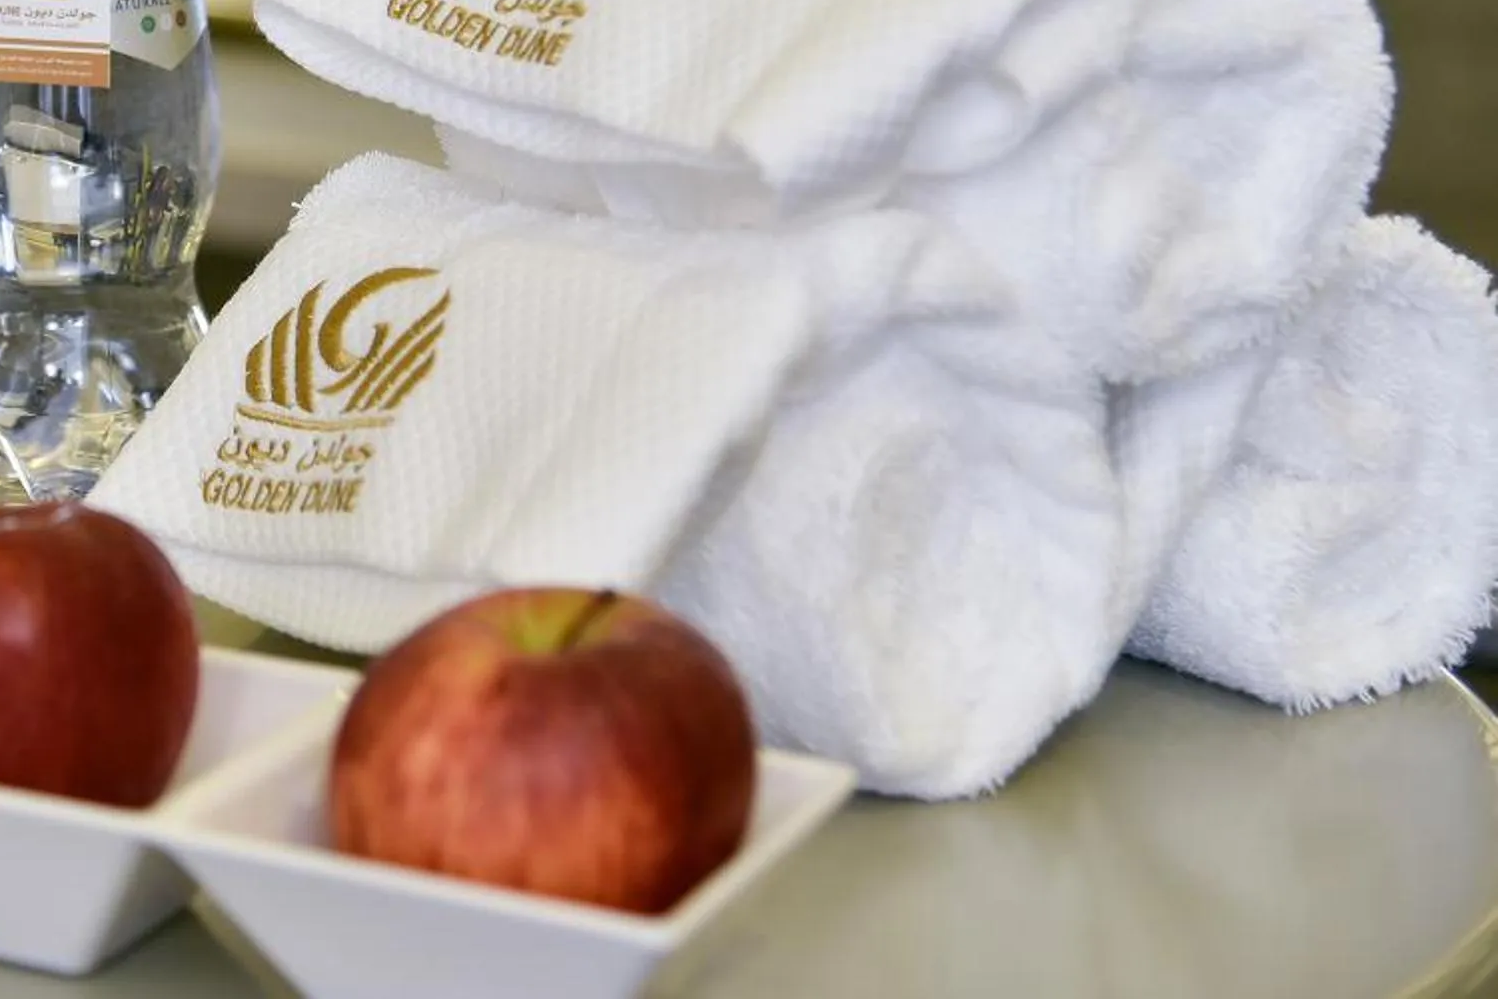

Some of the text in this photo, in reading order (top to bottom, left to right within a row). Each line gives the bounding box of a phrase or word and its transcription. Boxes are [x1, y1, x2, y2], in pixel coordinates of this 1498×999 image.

[495, 23, 573, 67] DUNE
[200, 468, 365, 515] GOLDEN DUNE
